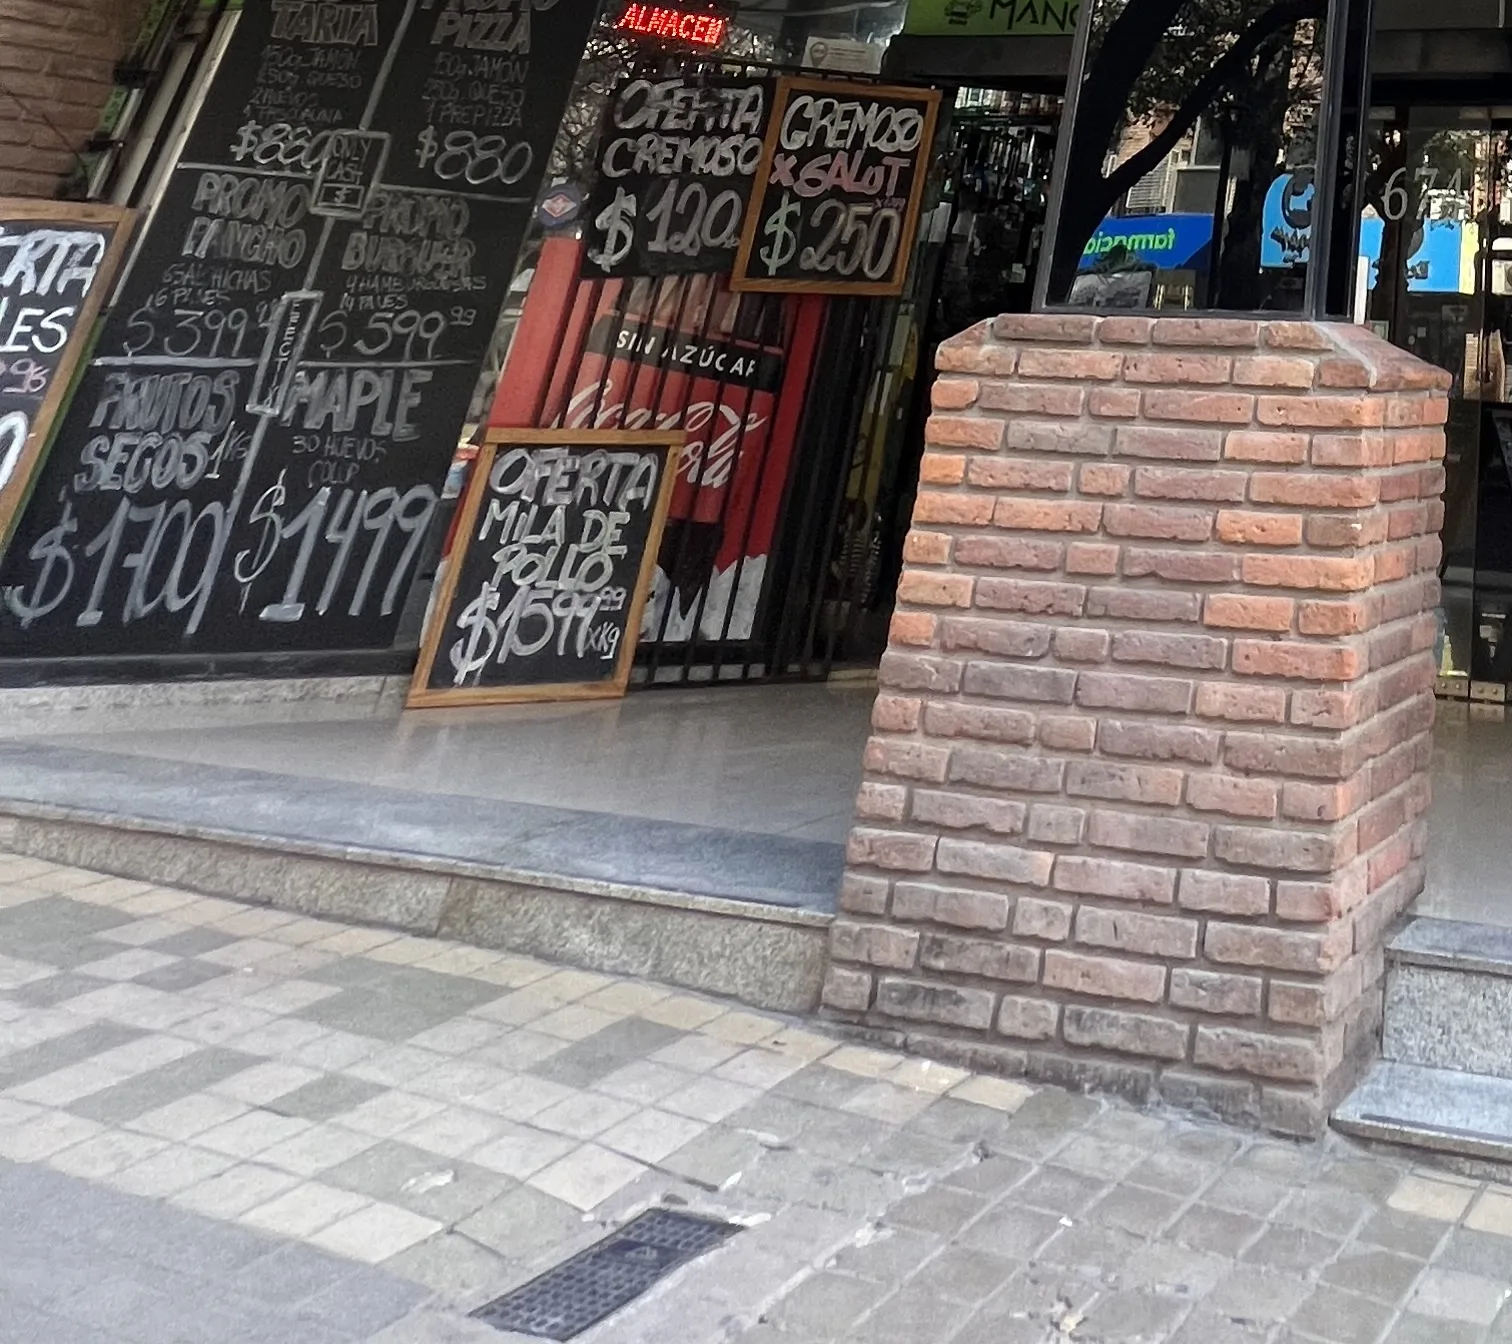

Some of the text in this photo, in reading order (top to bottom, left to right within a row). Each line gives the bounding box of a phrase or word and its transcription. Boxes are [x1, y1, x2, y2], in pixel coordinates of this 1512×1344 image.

[430, 11, 532, 55] PIZZA
[618, 2, 724, 44] ALMACEN
[415, 125, 533, 185] $880
[192, 171, 310, 229] PROMO
[616, 329, 657, 356] SIN
[281, 367, 434, 442] MAPLE
[292, 434, 320, 454] 30
[489, 445, 658, 512] OFERTA
[478, 497, 631, 560] MILA DE
[488, 541, 614, 593] POLLO
